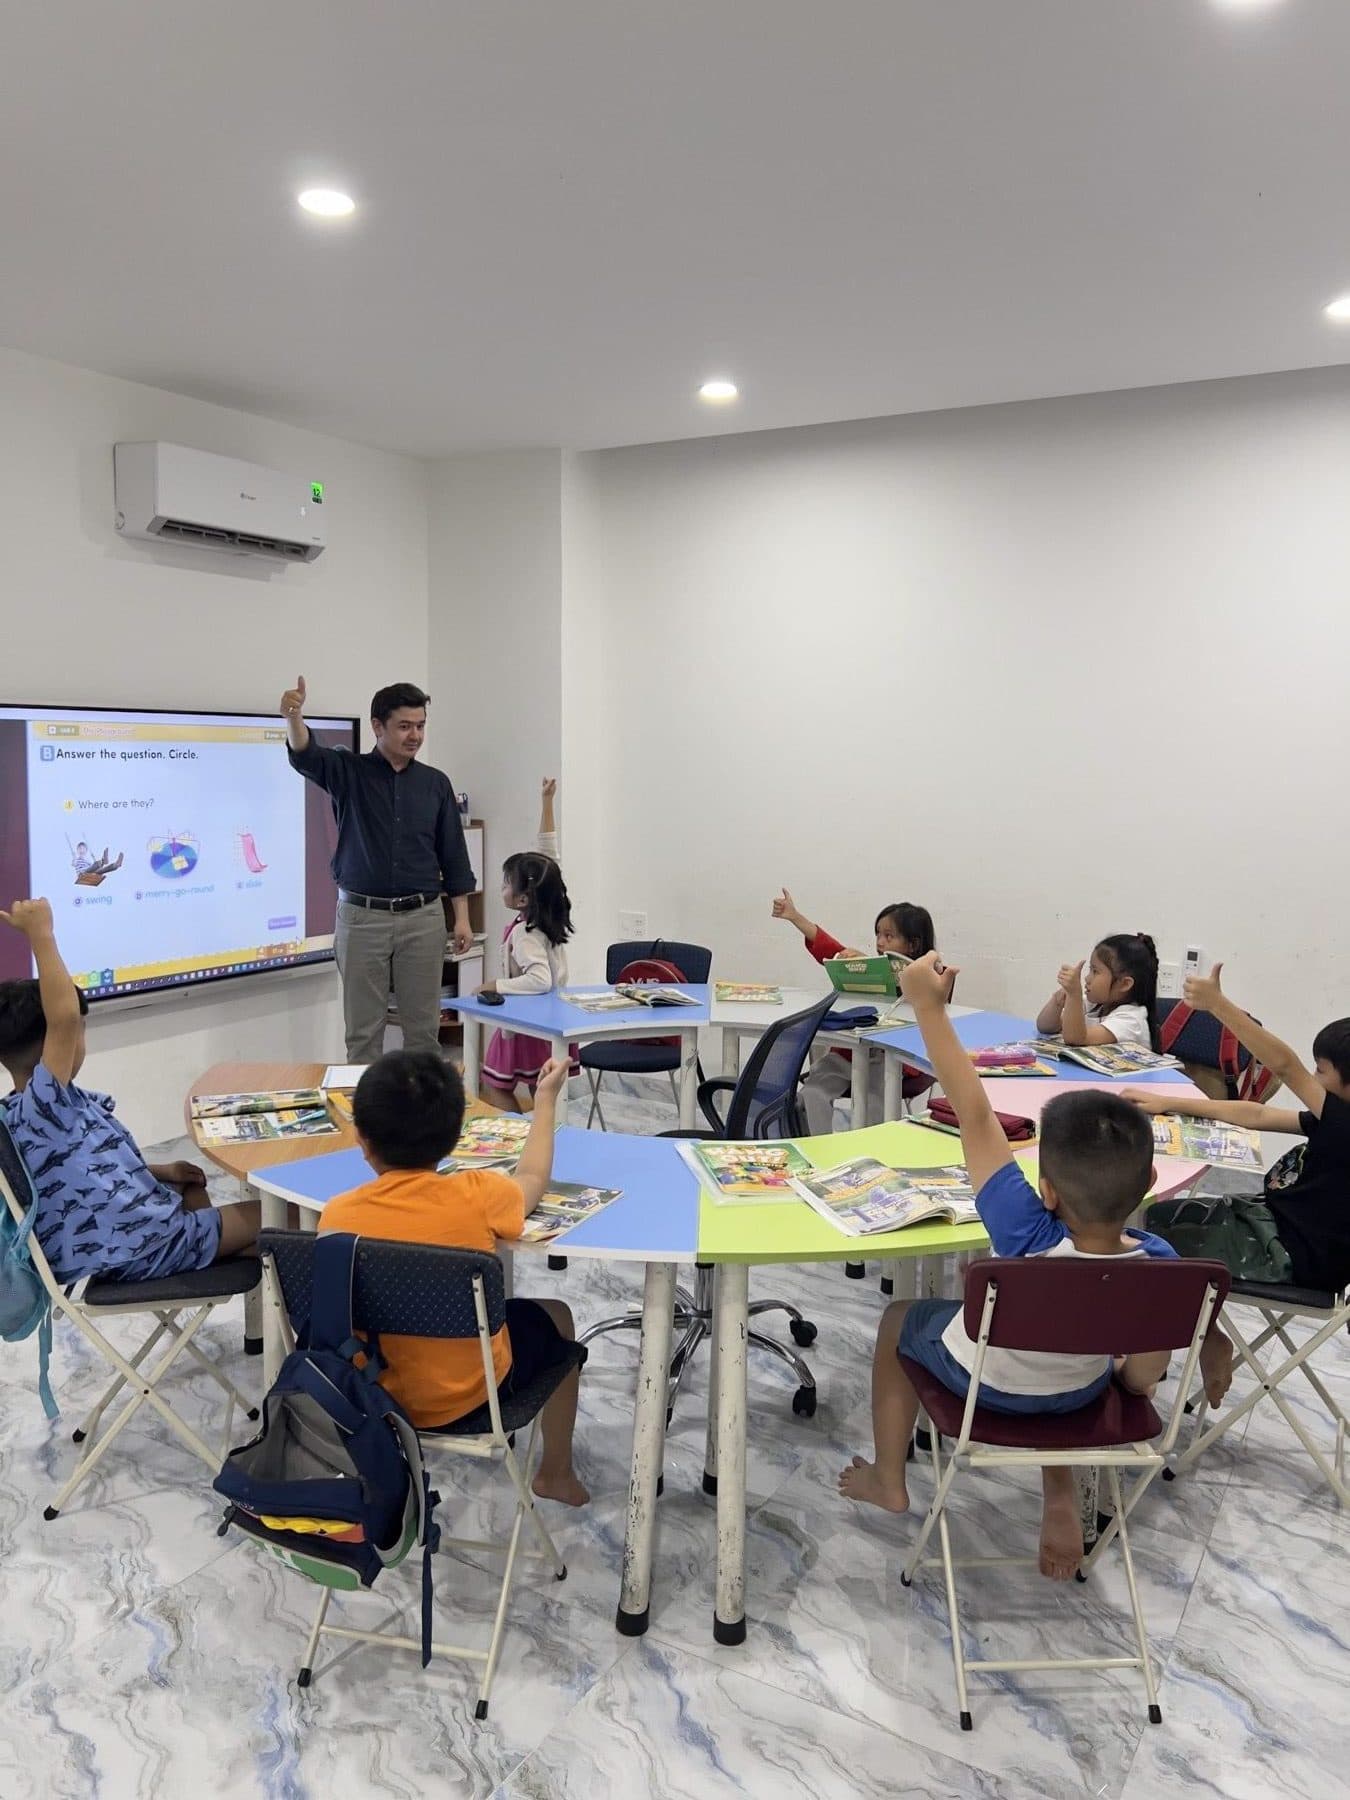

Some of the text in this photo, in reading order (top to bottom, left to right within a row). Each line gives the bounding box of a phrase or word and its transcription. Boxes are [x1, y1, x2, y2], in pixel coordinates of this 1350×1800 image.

[56, 748, 96, 759] Answer
[100, 748, 117, 759] the
[120, 748, 165, 762] question.
[168, 748, 199, 760] Circle.
[78, 799, 109, 809] Where
[112, 801, 128, 809] are
[130, 797, 155, 810] they?
[145, 883, 215, 898] merry-go-round
[85, 895, 112, 906] swing
